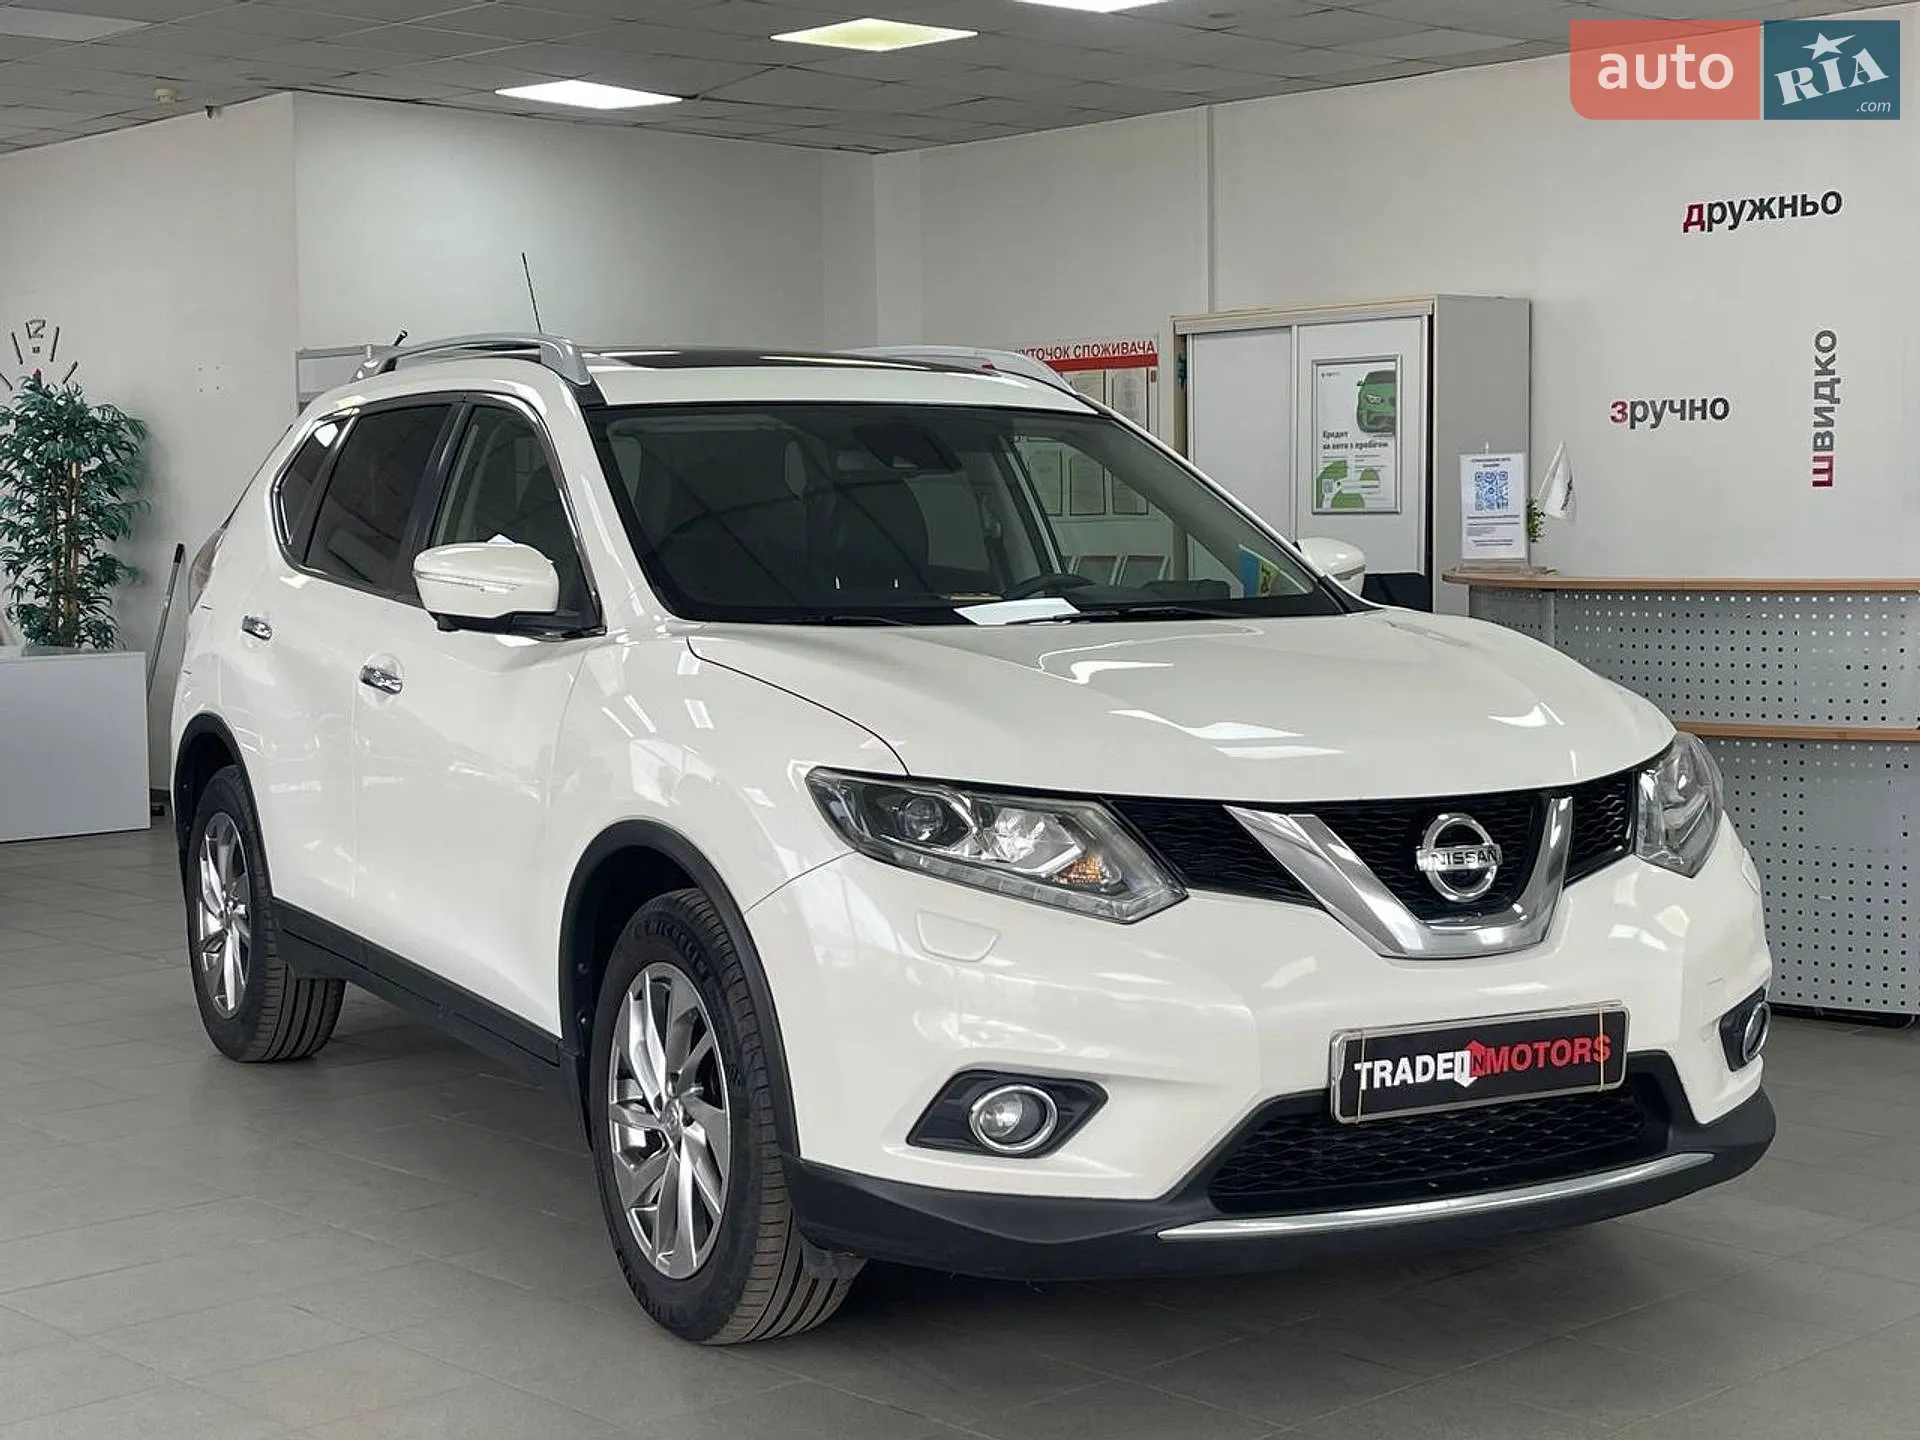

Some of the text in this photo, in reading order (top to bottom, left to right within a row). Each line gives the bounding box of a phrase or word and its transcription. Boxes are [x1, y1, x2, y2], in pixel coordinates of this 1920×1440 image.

[1682, 190, 1843, 234] дружньо
[1073, 340, 1155, 358] СПОЖИВАЧА
[1610, 395, 1730, 430] зручно
[1812, 329, 1841, 488] швидко
[1430, 848, 1498, 866] NISSAN
